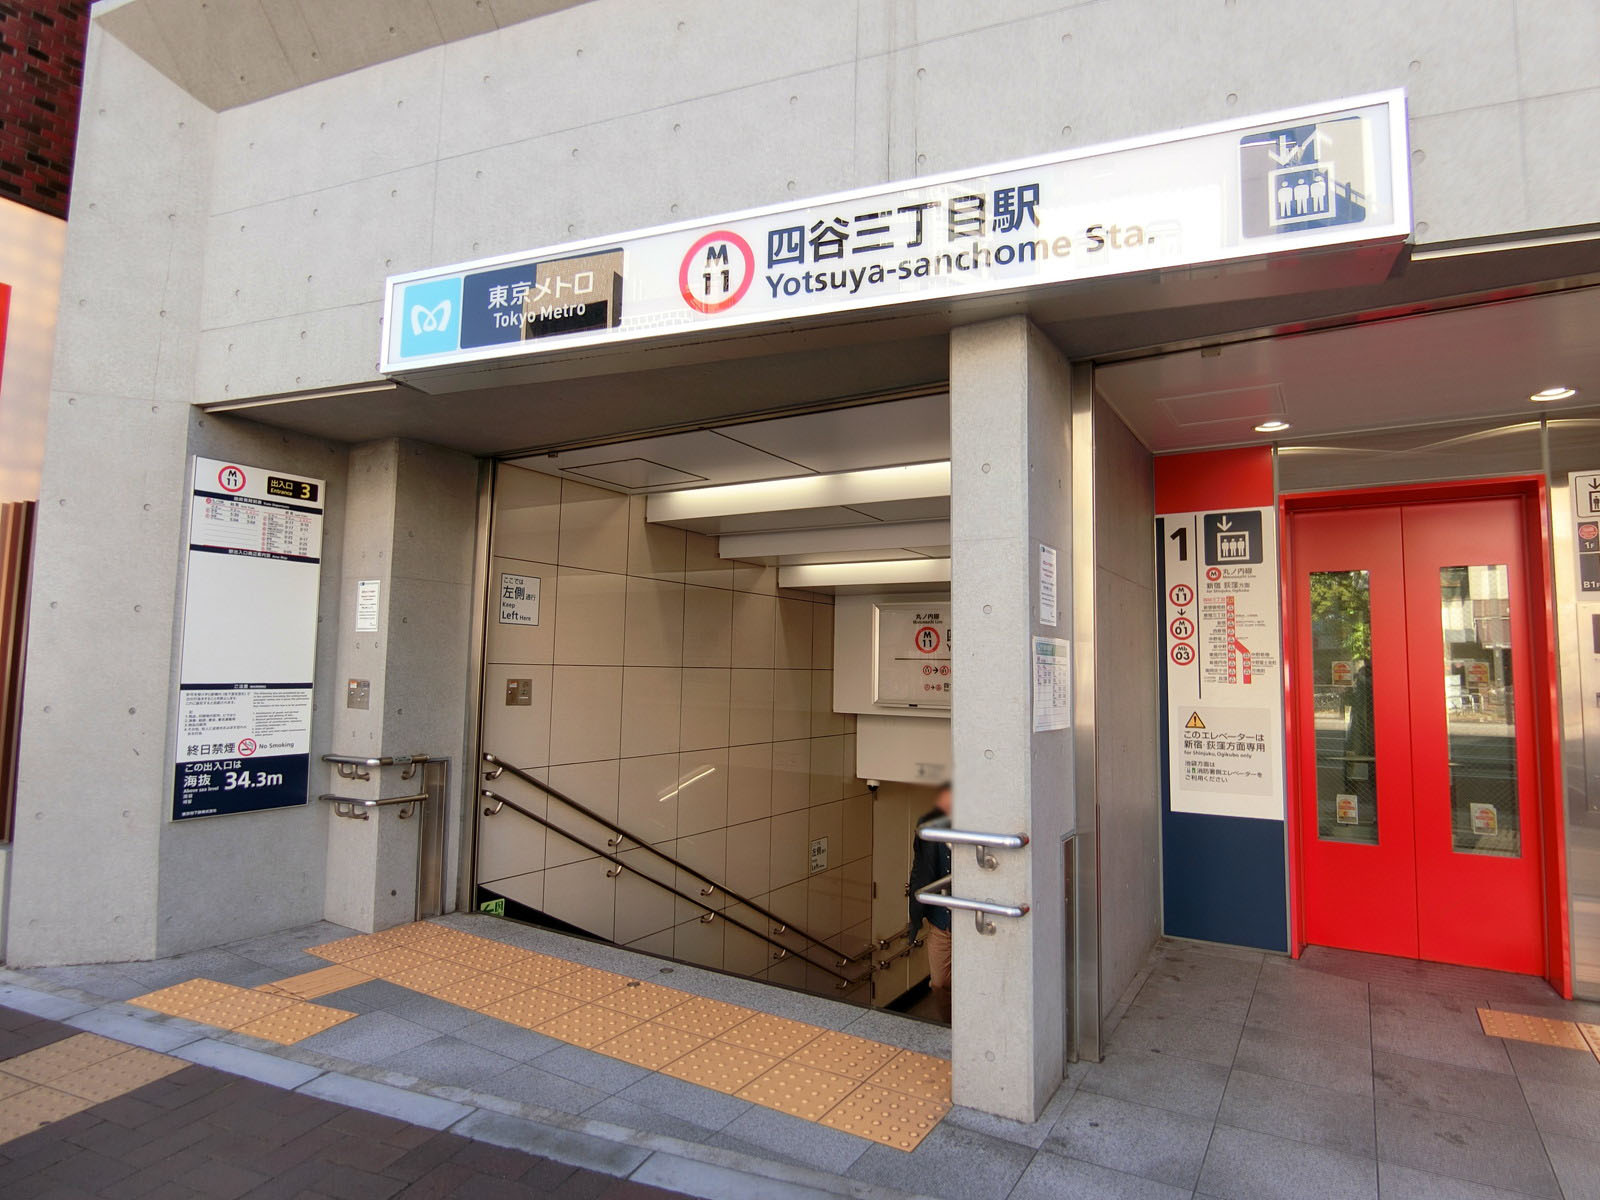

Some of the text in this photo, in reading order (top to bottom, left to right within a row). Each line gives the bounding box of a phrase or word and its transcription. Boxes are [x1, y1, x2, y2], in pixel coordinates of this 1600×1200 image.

[767, 183, 1041, 269] 四谷三丁目駅
[705, 244, 729, 268] M
[766, 221, 1156, 299] Yotsuya-sanchome Sta.
[702, 269, 730, 296] 11
[488, 270, 595, 311] 東京メトロ
[493, 303, 587, 330] Tokyo Metro
[228, 470, 237, 478] M
[226, 478, 238, 487] 11
[271, 479, 293, 490] 出入口
[270, 487, 293, 496] Entrance
[300, 483, 311, 499] 3
[1170, 527, 1187, 561] 1
[1223, 568, 1253, 576] 丸ノ内線
[503, 576, 524, 585] ここでは
[1175, 593, 1187, 602] 11
[502, 601, 516, 609] Keep
[501, 610, 519, 621] Left
[1174, 626, 1188, 635] 01
[922, 639, 932, 647] 11
[1175, 651, 1190, 661] 03
[1183, 730, 1264, 742] このエレベーターは
[187, 742, 236, 756] 終日禁煙
[184, 760, 242, 773] この出入口は
[183, 774, 211, 787] 海抜
[224, 770, 283, 790] 34.3m
